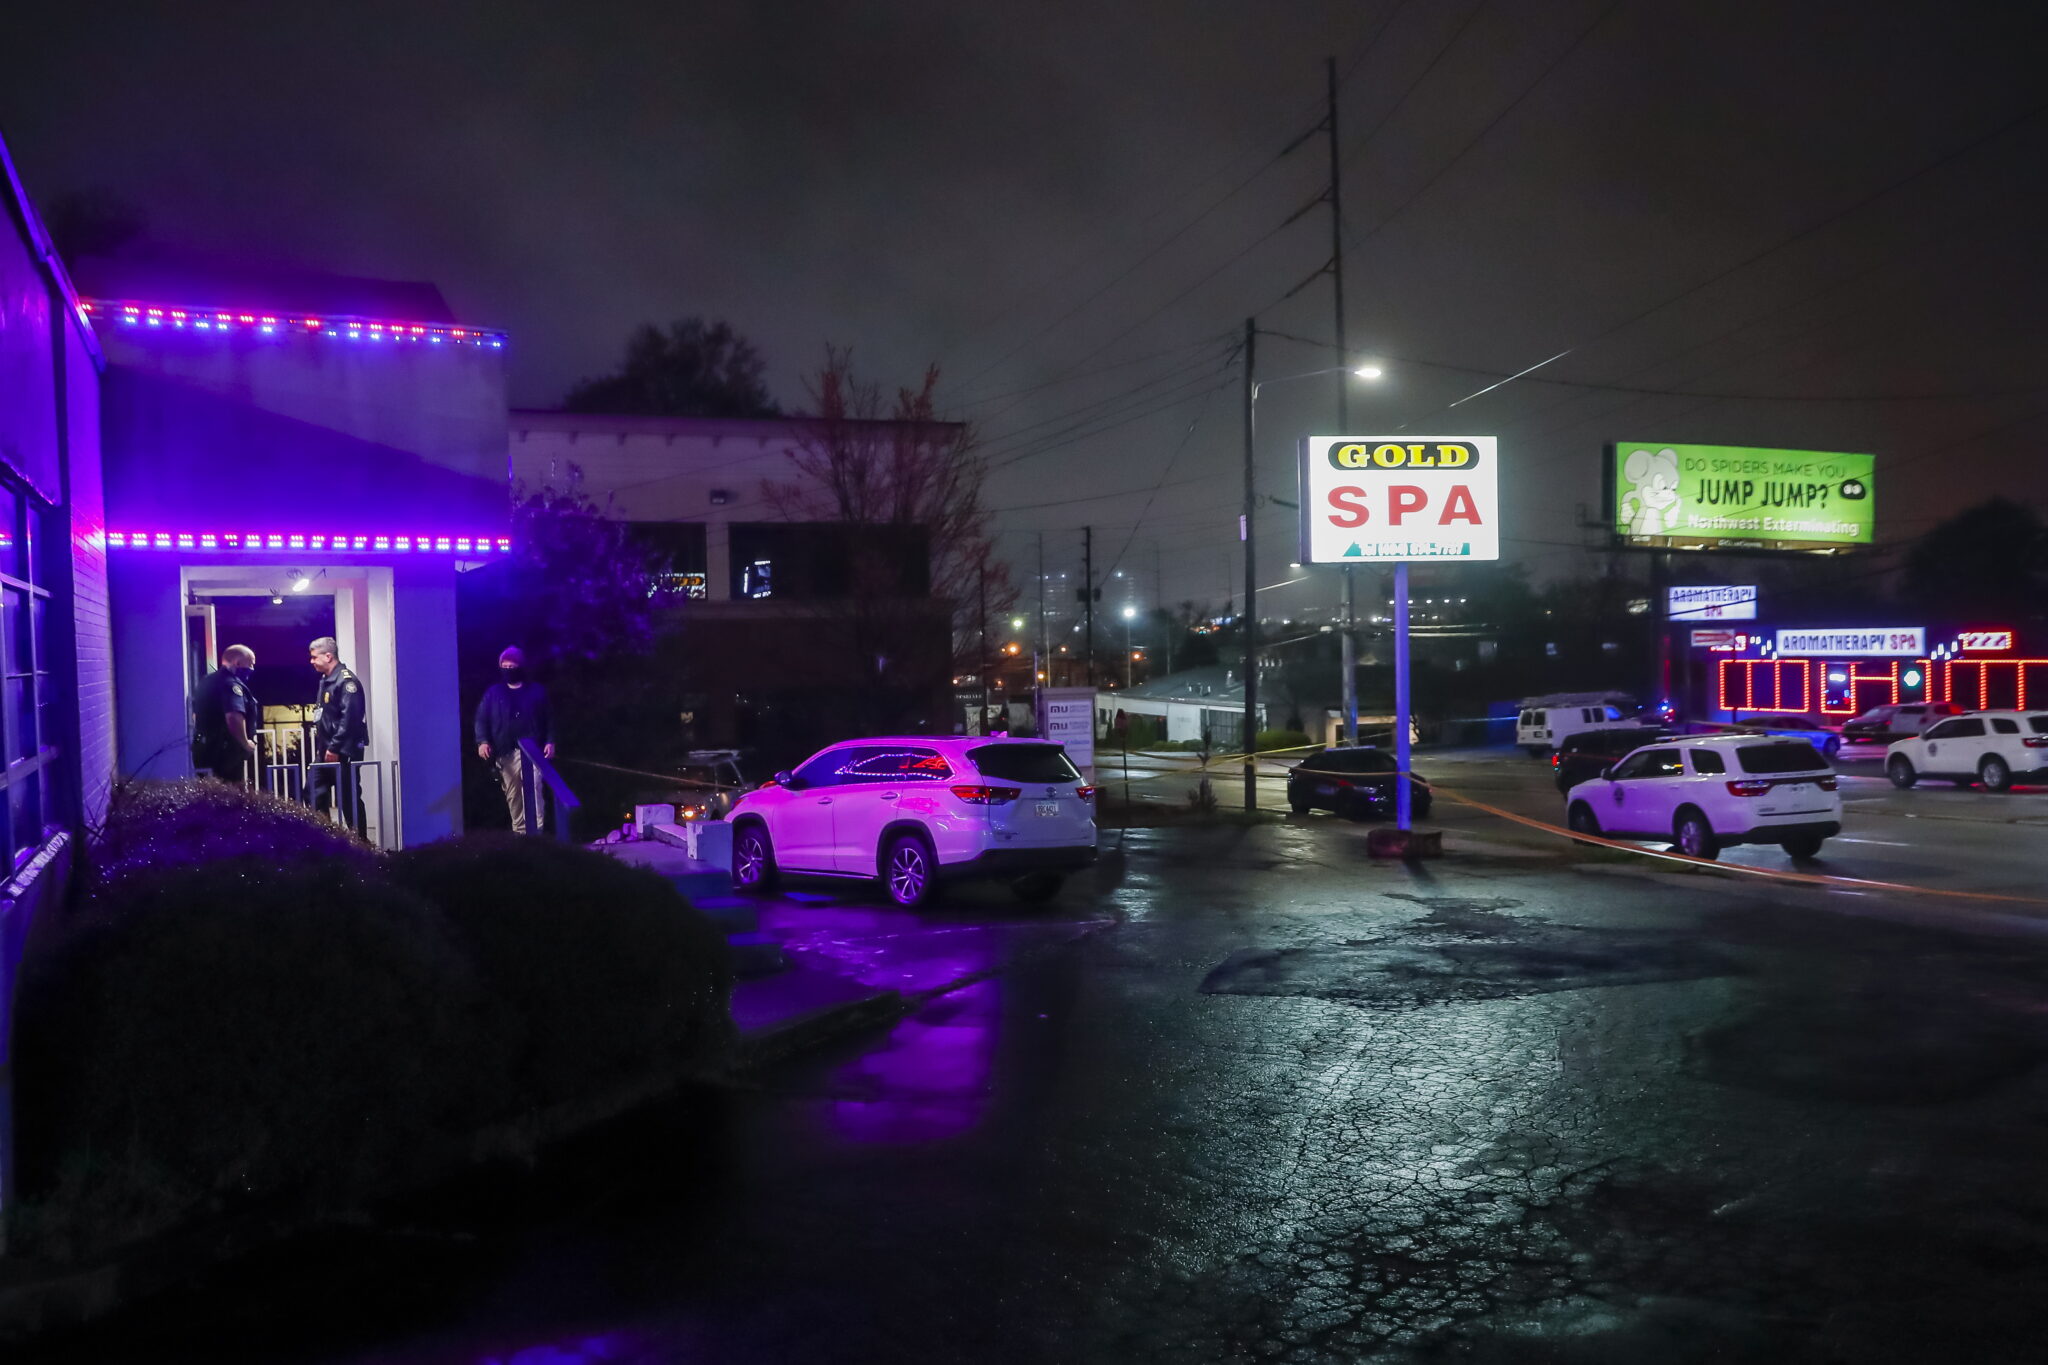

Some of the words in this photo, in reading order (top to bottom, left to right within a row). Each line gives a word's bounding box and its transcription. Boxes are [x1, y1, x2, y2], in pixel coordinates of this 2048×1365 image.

[1338, 444, 1470, 468] GOLD
[1685, 458, 1706, 472] DO
[1711, 459, 1769, 475] SPIDERS
[1773, 462, 1811, 476] MAKE
[1817, 464, 1847, 479] YOU
[1696, 478, 1754, 505] JUMP
[1761, 480, 1828, 509] JUMP?
[1327, 485, 1483, 528] SPA
[1687, 514, 1760, 531] Northwest
[1763, 516, 1860, 537] Exterminating
[1673, 588, 1752, 602] AROMATHERAPY
[1783, 634, 1886, 652] AROMATHERAPY
[1889, 634, 1917, 651] SPA
